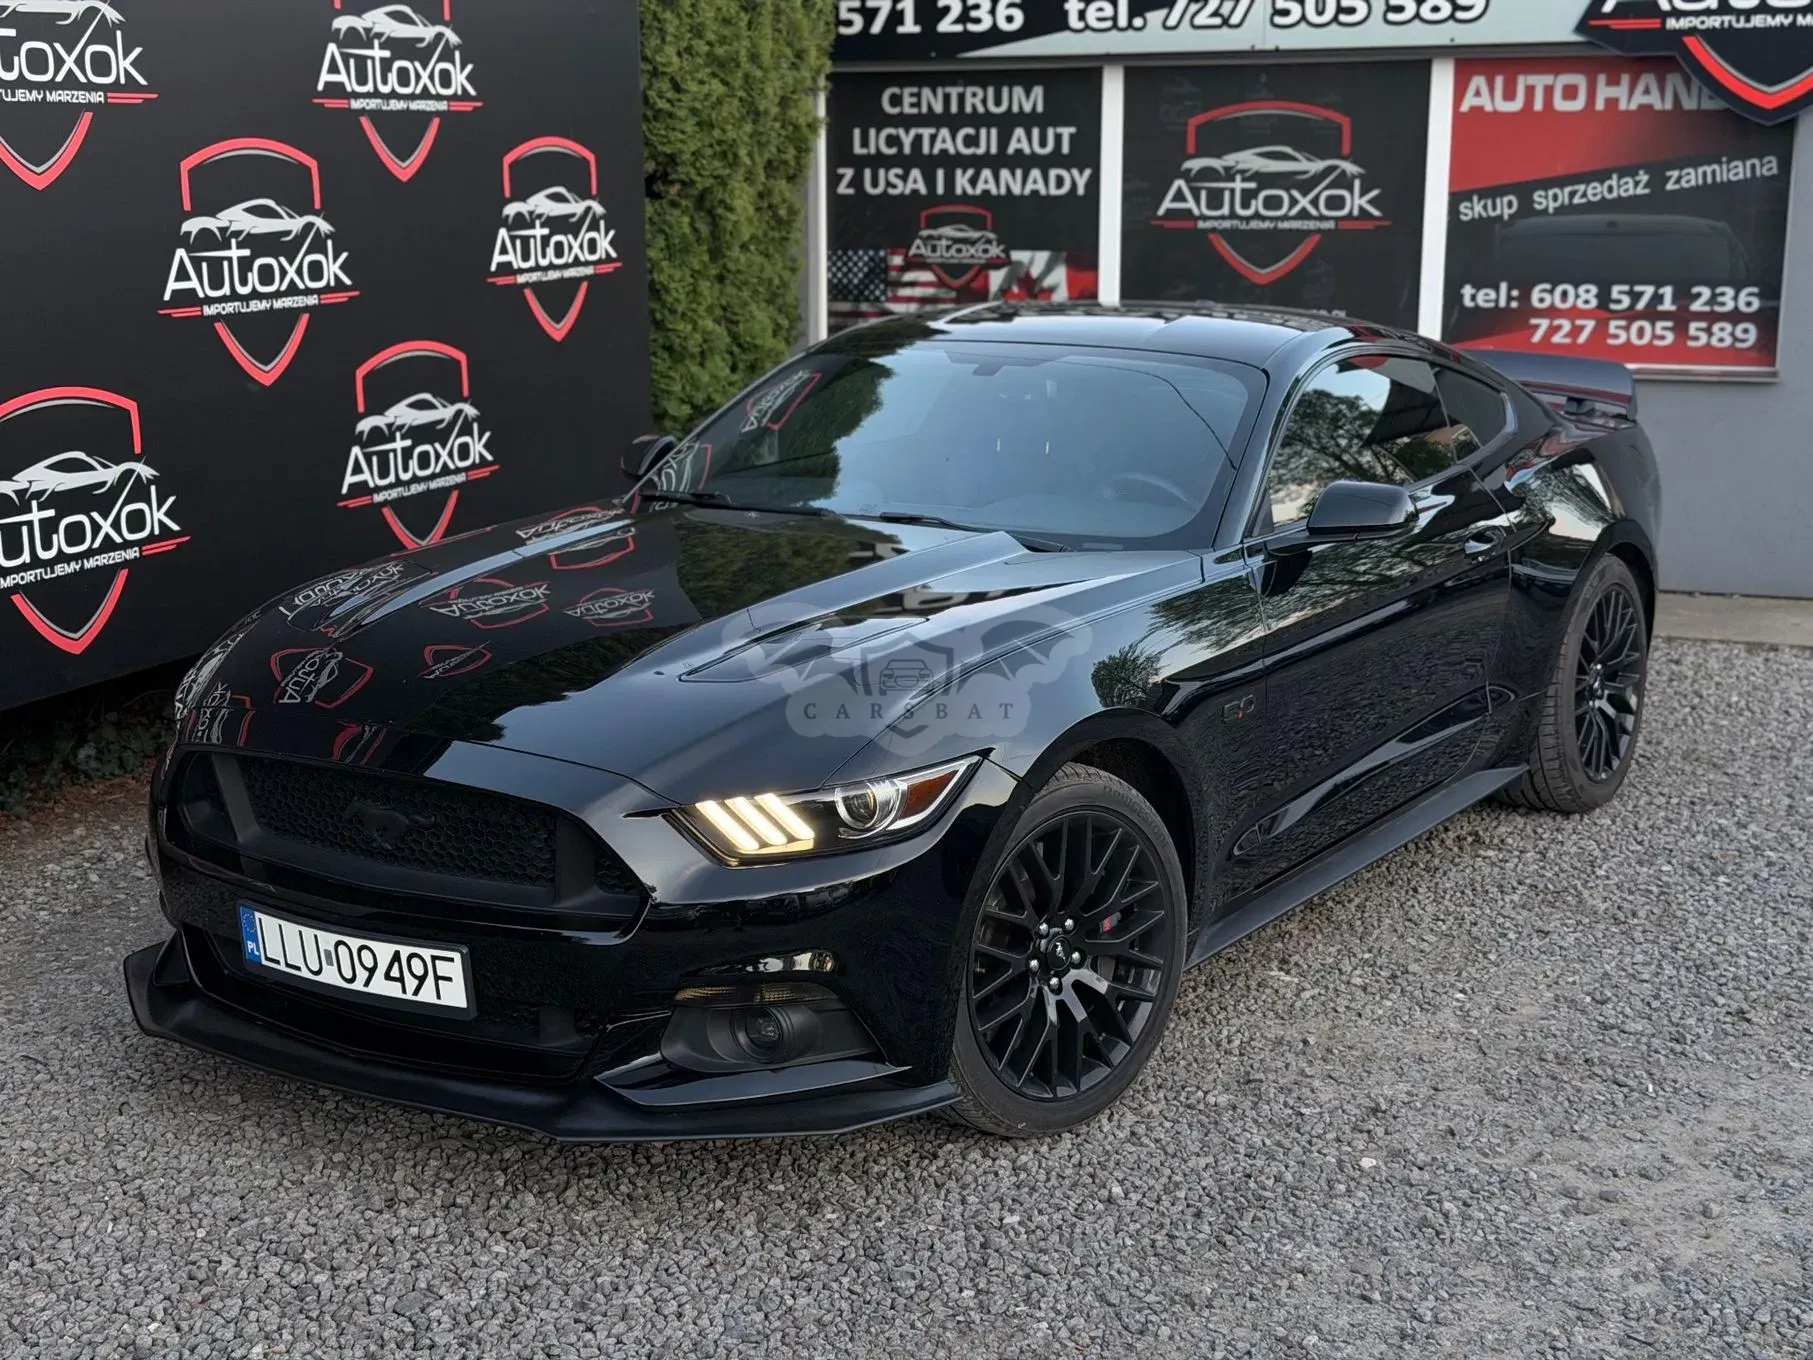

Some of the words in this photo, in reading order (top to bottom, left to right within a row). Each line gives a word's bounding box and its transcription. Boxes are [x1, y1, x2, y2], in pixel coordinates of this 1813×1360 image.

[837, 0, 922, 35] 571
[936, 0, 1025, 33] 236
[1064, 0, 1146, 30] tel.
[1665, 14, 1794, 30] IMPORTUJEMY
[317, 38, 477, 96] Autoxok
[46, 89, 105, 104] MARZENIA
[881, 85, 1044, 115] CENTRUM
[1458, 73, 1587, 113] AUTO
[853, 127, 999, 156] LICYTACJI
[1007, 126, 1077, 155] AUT
[836, 167, 855, 195] Z
[863, 167, 928, 196] USA
[936, 167, 945, 196] I
[954, 167, 1092, 196] KANADY
[1156, 173, 1384, 217] Autoxok
[1458, 194, 1519, 222] skup
[1532, 170, 1651, 214] sprzedaż
[1664, 155, 1779, 192] zamiana
[490, 219, 618, 272] Autoxok
[908, 238, 1007, 259] Autoxok
[163, 238, 353, 301] Autoxok
[202, 299, 272, 317] IMPORTUJEMY
[272, 294, 319, 310] MARZENIA
[1460, 281, 1519, 308] tel:
[1530, 283, 1599, 310] 608
[1608, 285, 1677, 312] 571
[1688, 286, 1761, 313] 236
[1528, 318, 1597, 344] 727
[1606, 319, 1675, 346] 505
[1686, 321, 1758, 348] 589
[341, 421, 494, 495] Autoxok
[0, 559, 82, 589] MPORTUJEMY
[84, 547, 140, 570] MARZENIA
[246, 940, 260, 955] PL
[258, 917, 323, 977] LLU
[333, 939, 455, 1000] 0949F
